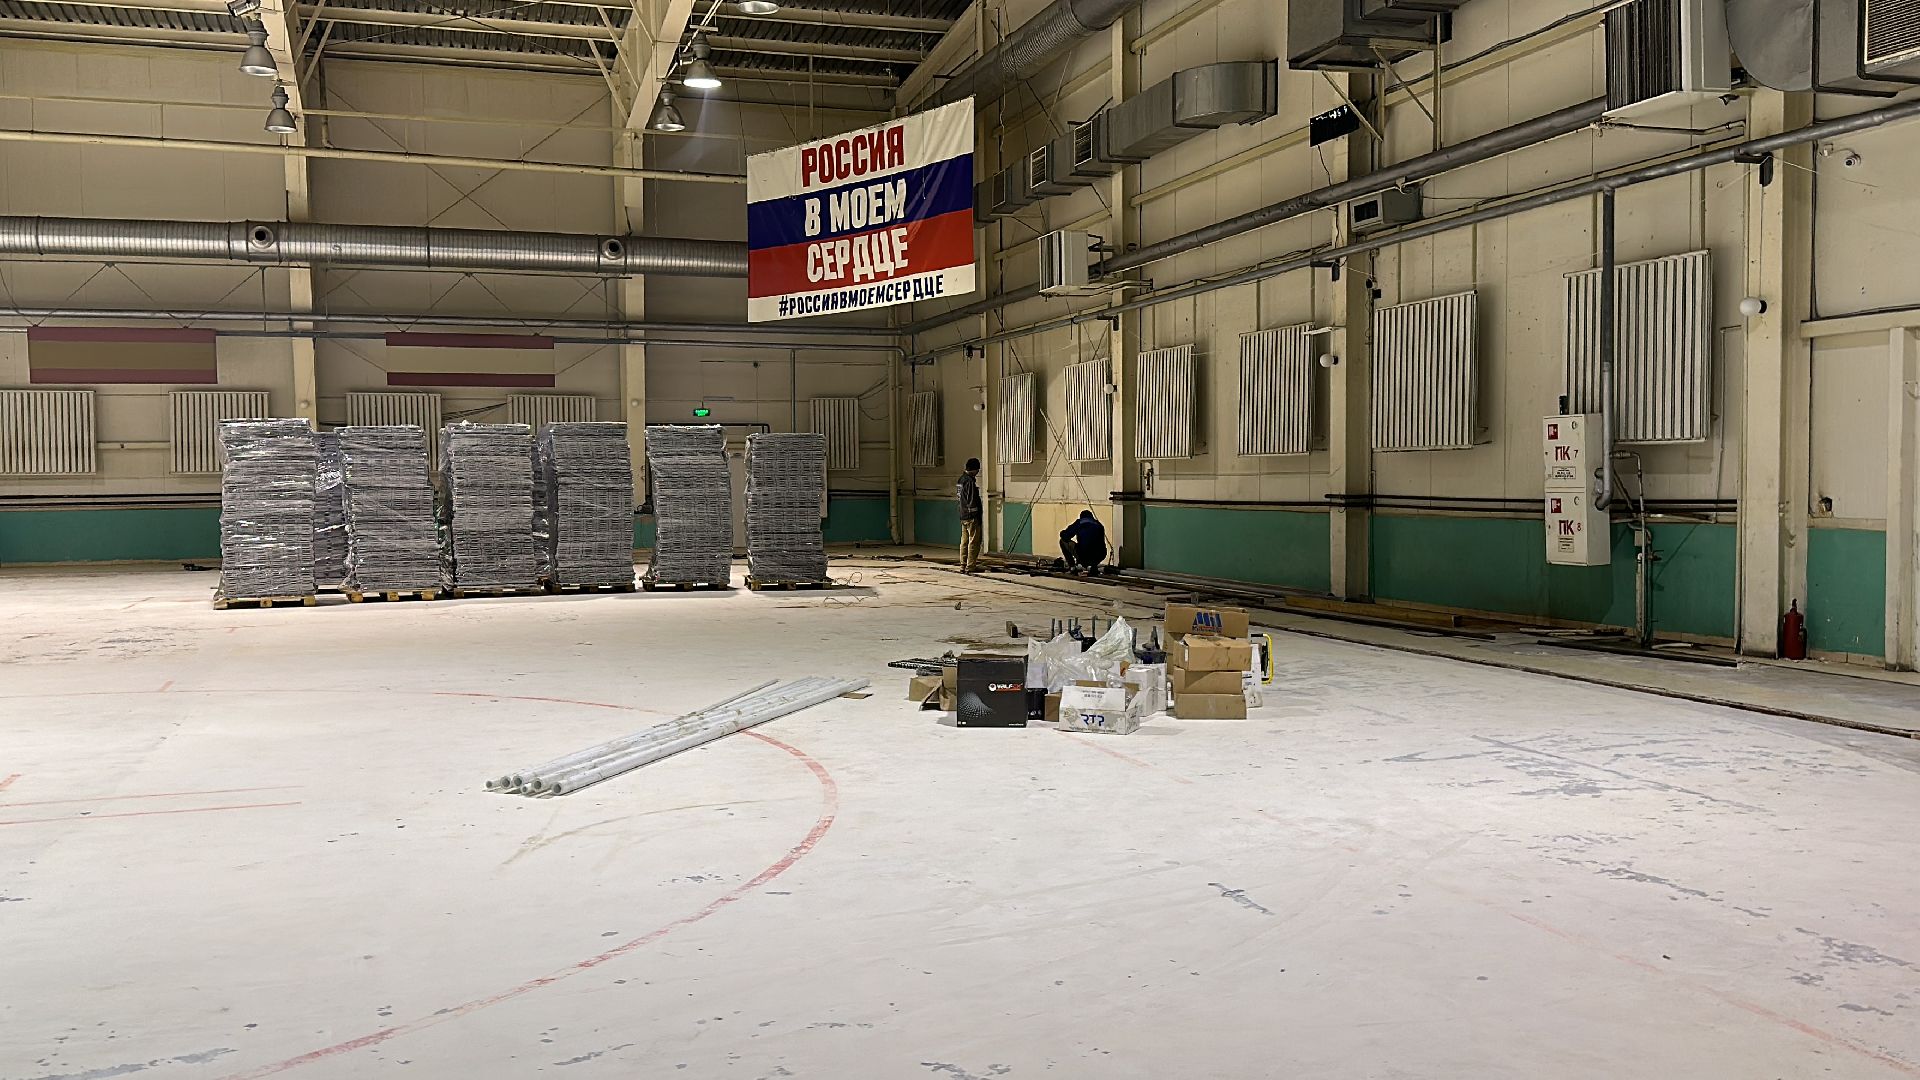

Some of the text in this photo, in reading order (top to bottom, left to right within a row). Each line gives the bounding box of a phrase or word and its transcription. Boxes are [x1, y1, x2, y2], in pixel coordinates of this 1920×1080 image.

[801, 125, 905, 187] РОССИЯ
[804, 178, 907, 237] В МОЕМ
[806, 228, 908, 283] СЕРДЦЕ
[779, 274, 944, 316] #РОССИЯВМОЕМСЕРДЦЕ
[1555, 446, 1579, 462] ПК 7
[1558, 519, 1575, 535] ПК
